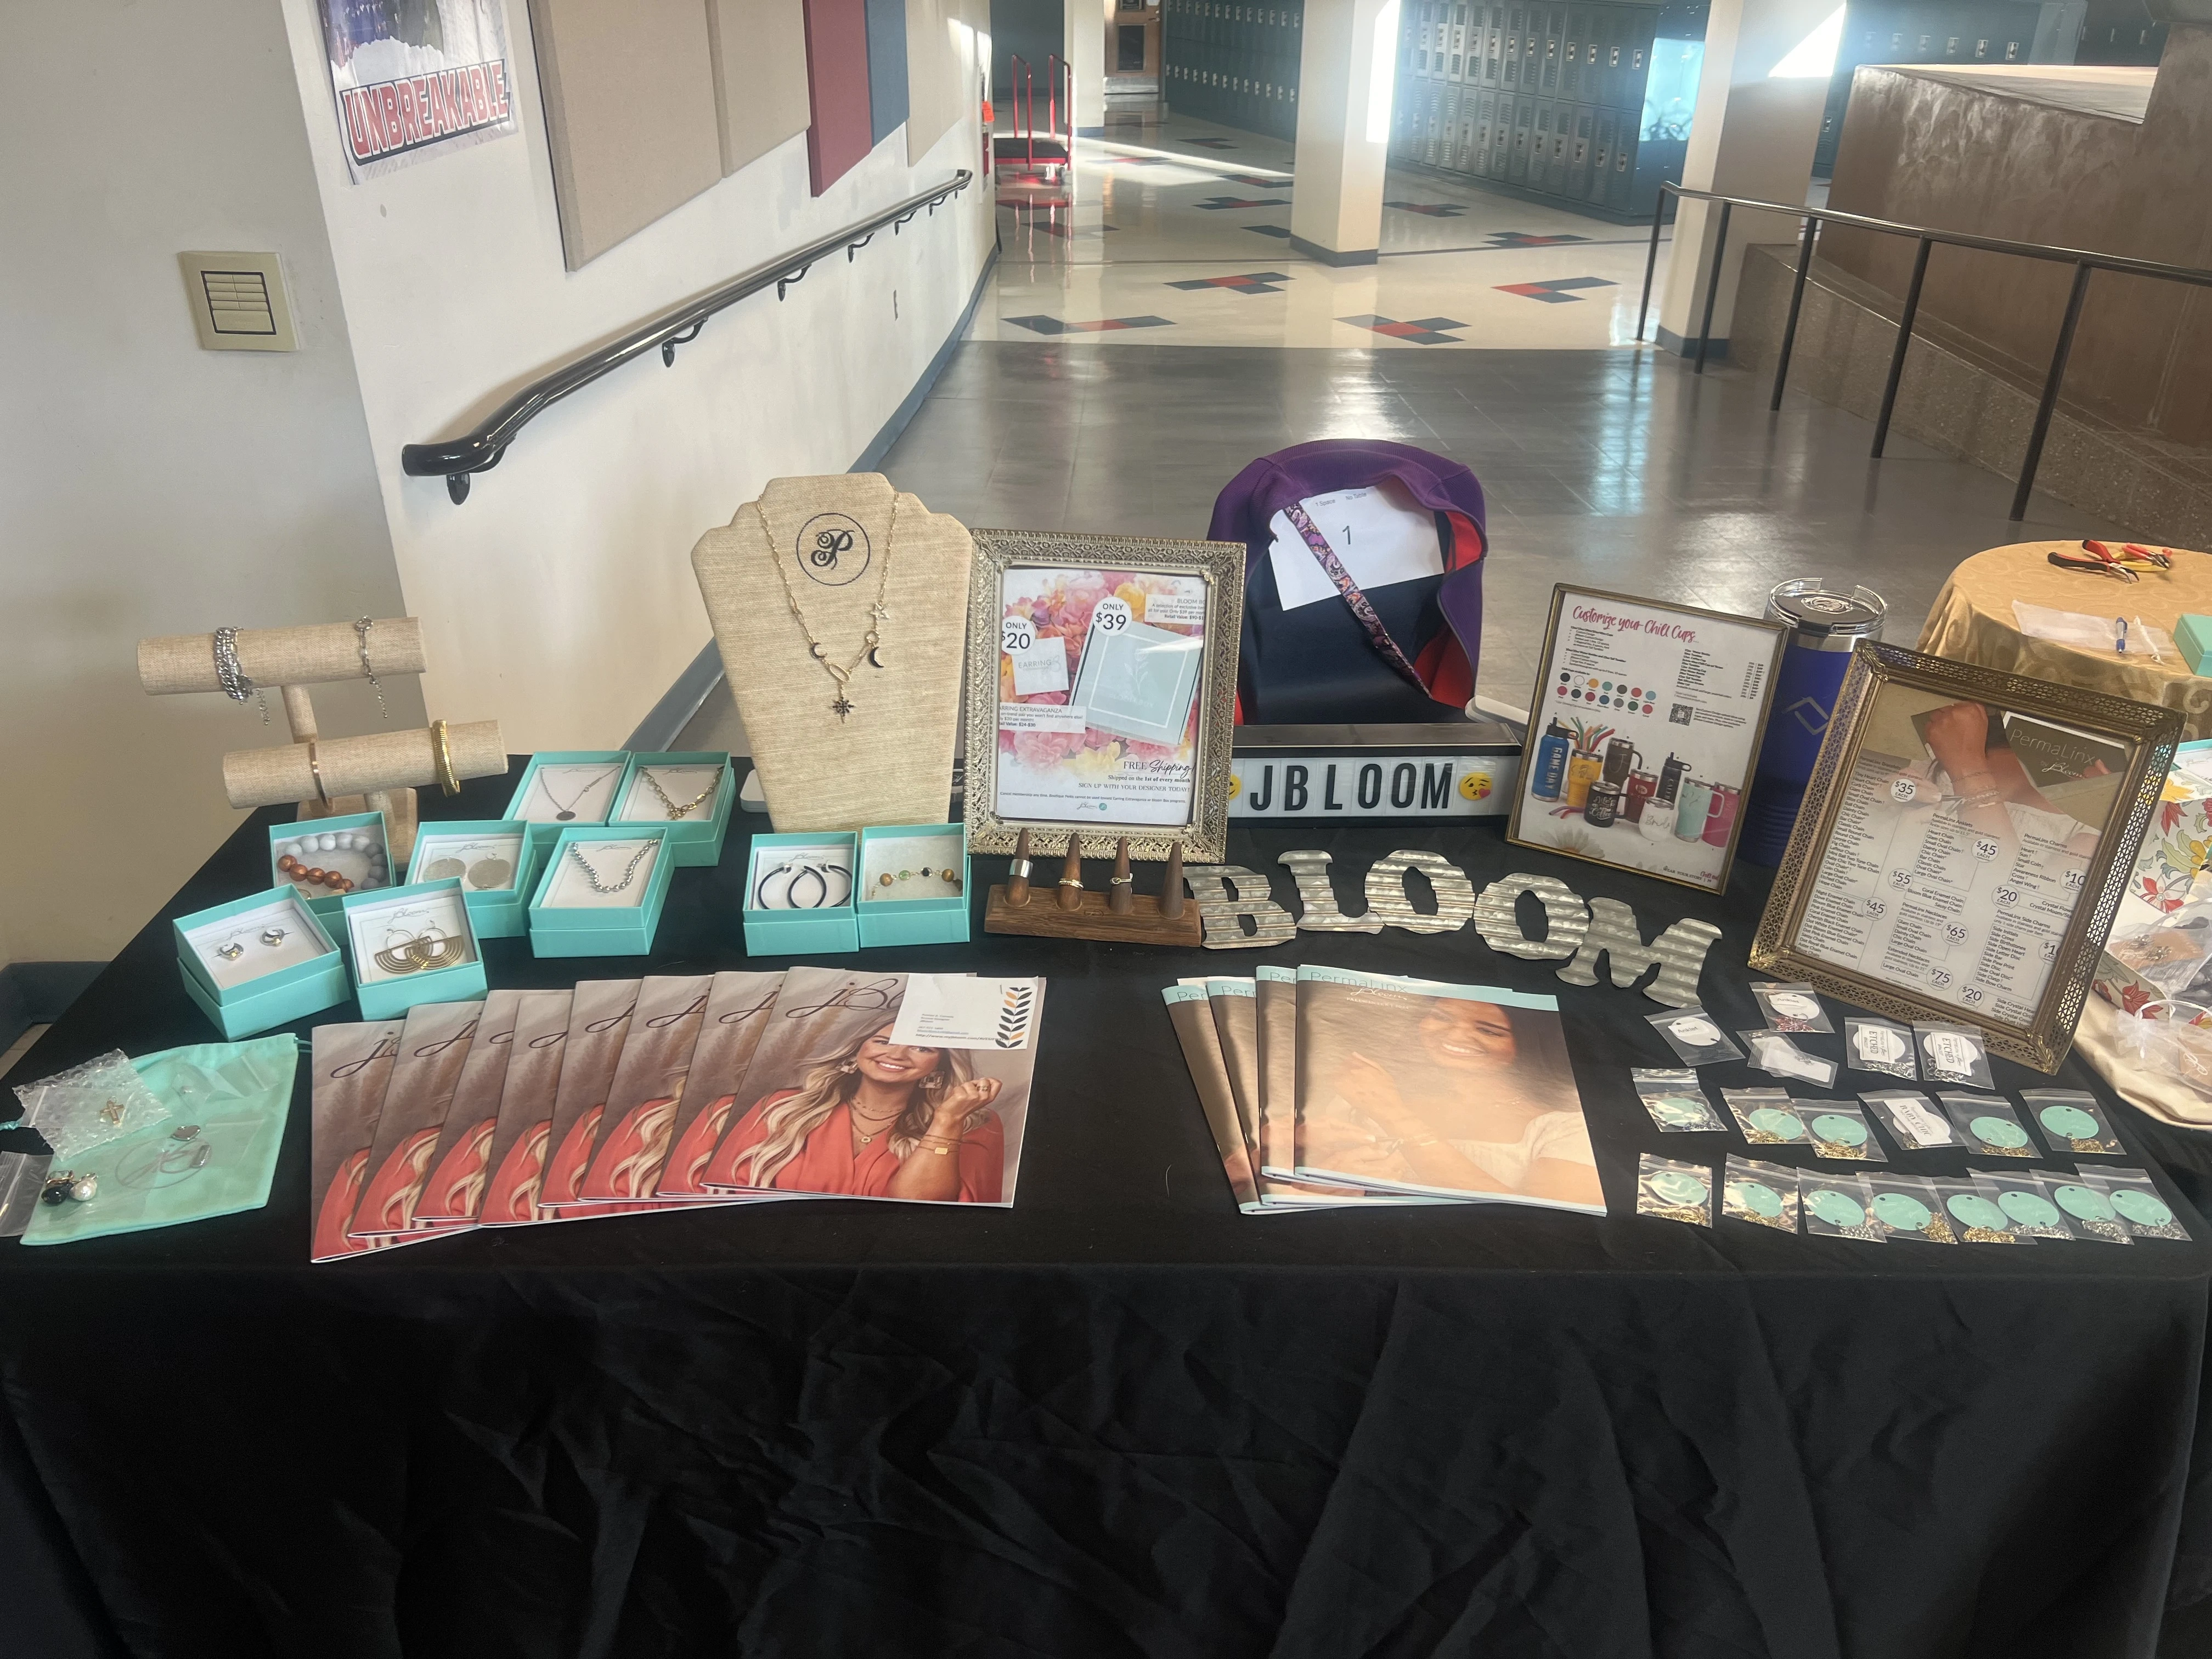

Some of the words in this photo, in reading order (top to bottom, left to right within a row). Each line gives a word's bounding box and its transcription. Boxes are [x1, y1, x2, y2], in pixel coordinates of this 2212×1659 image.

[341, 60, 510, 161] UNBREAKABLE
[1342, 525, 1351, 545] 1
[1096, 611, 1126, 630] $39
[1572, 605, 1616, 630] Customize
[1617, 617, 1644, 631] your
[1644, 619, 1668, 637] Chill
[1002, 631, 1030, 650] $20
[1018, 659, 1052, 669] EARRING
[2010, 727, 2096, 765] PermaLinx
[1549, 746, 1563, 770] GAME
[1123, 761, 1148, 770] FREE
[1149, 759, 1197, 778] Shipping!
[1544, 772, 1558, 789] DAY
[1894, 781, 1914, 794] $35
[1922, 844, 1937, 852] Dainty
[1976, 840, 1997, 855] $45
[2024, 833, 2049, 843] PermaLinx
[2049, 840, 2067, 848] Charms
[1689, 872, 1702, 881] STORY
[1892, 871, 1911, 884] $55
[2012, 867, 2038, 878] Awareness
[2039, 874, 2056, 883] Ribbon
[2064, 870, 2086, 885] $10
[1932, 895, 1949, 904] Enamel
[1933, 890, 1950, 899] Enamel
[1996, 887, 2017, 901] $20
[1866, 899, 1884, 913] $45
[1925, 909, 1947, 919] Necklaces
[1996, 909, 2021, 919] PermaLinx
[2032, 919, 2050, 928] Charms
[1184, 849, 1723, 1009] BLOOM
[1946, 924, 1966, 938] $65
[1887, 946, 1908, 956] Extended
[1310, 971, 1408, 994] PermaLinx
[1931, 968, 1950, 983] $75
[1962, 986, 1982, 1001] $20
[1869, 1030, 1879, 1054] ETCHED
[1942, 1037, 1955, 1063] ETCHED
